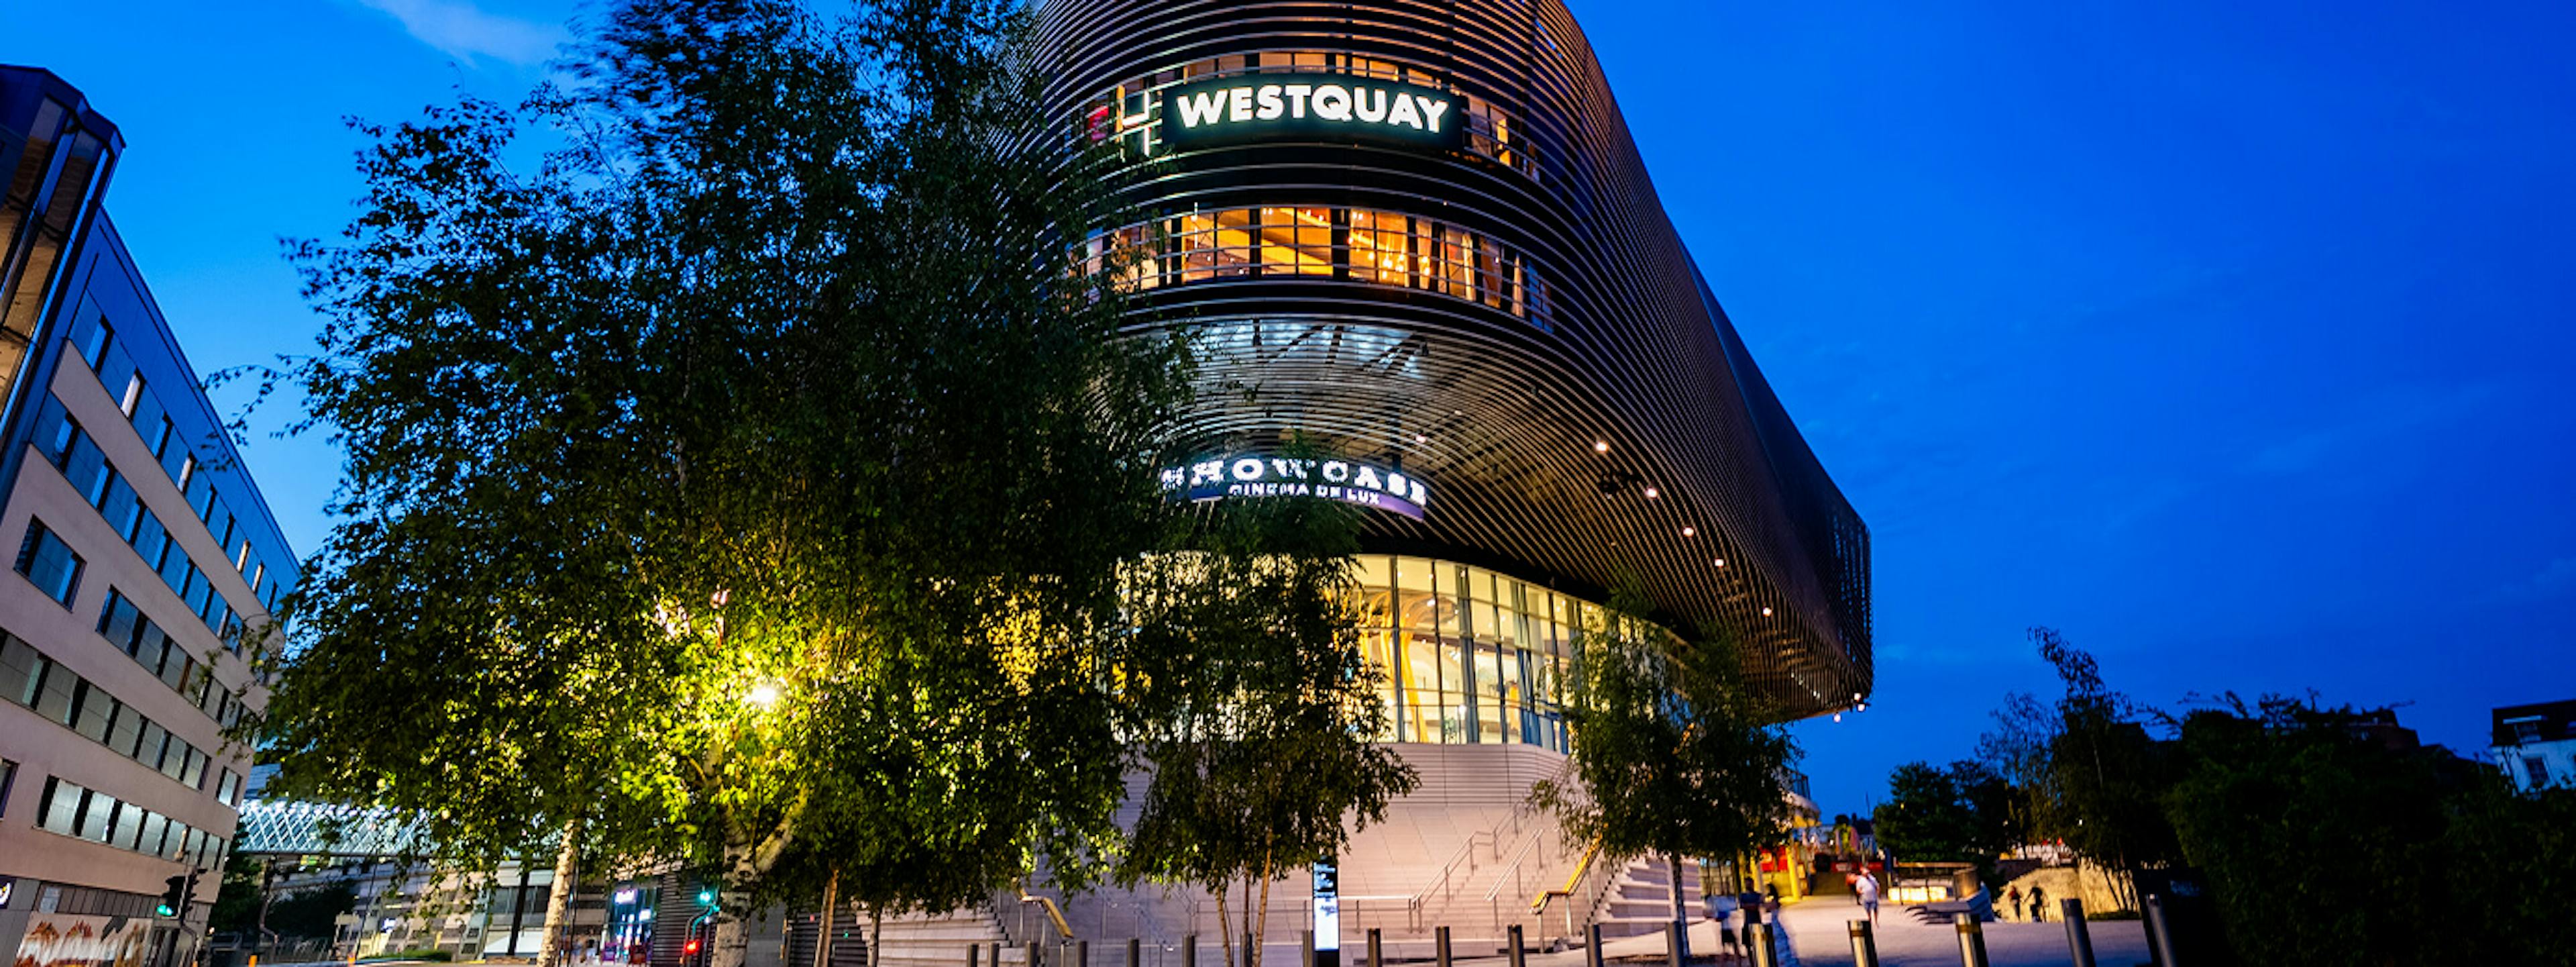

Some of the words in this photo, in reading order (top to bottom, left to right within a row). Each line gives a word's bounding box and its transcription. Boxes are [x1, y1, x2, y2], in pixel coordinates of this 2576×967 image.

[1177, 85, 1448, 133] WESTQUAY
[1228, 482, 1309, 497] CINEMA
[1315, 483, 1342, 499] DE
[1346, 487, 1381, 505] LUX
